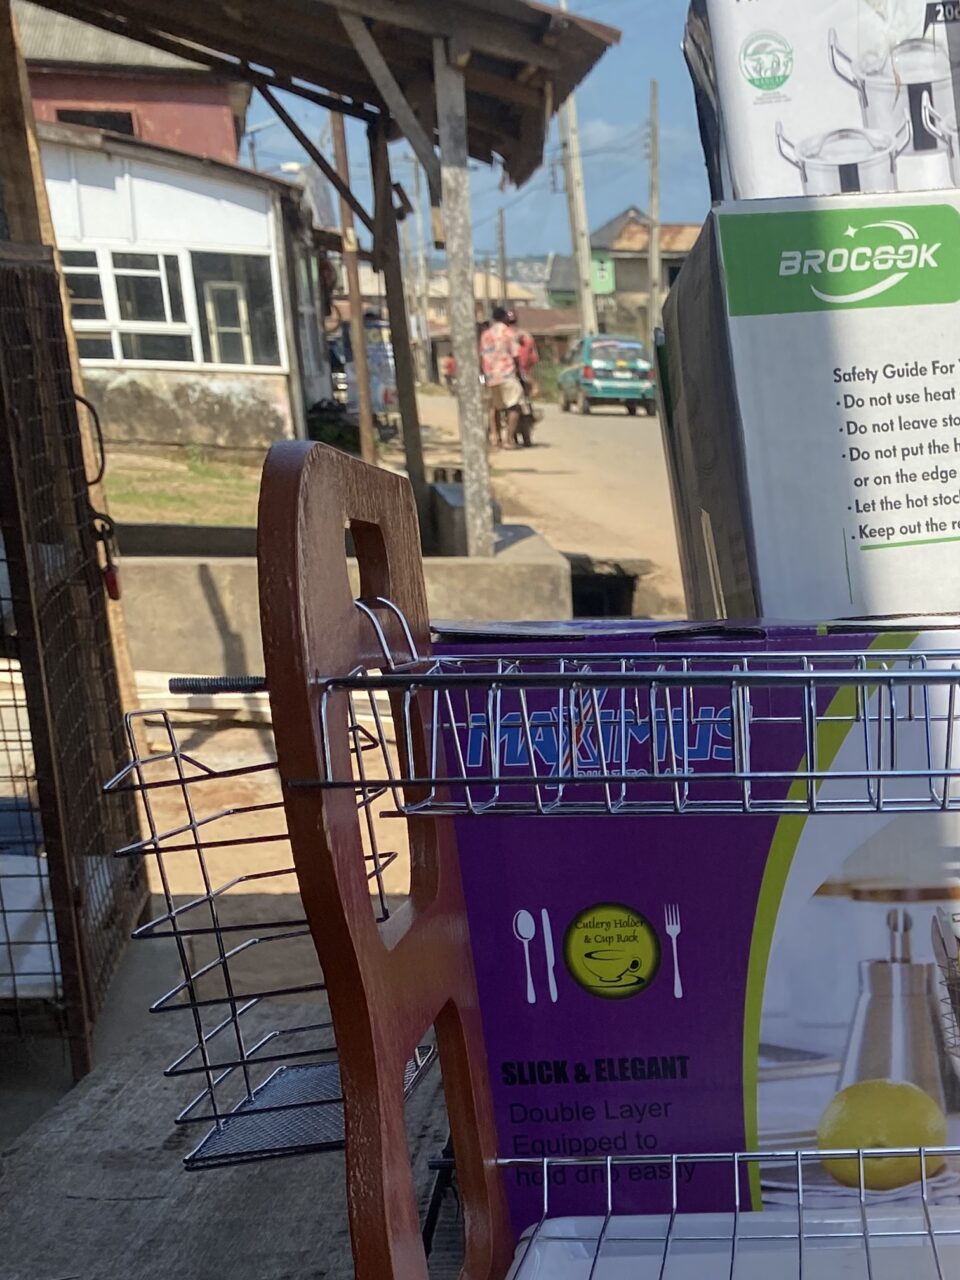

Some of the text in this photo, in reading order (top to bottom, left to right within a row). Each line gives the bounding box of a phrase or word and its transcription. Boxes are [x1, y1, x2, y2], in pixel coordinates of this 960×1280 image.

[779, 243, 941, 276] BROCOOK
[833, 366, 878, 384] Safety
[883, 361, 928, 379] Guide
[931, 360, 955, 376] For
[843, 394, 865, 409] Do
[869, 392, 892, 407] not
[896, 391, 920, 405] use
[924, 386, 956, 402] heat
[845, 421, 868, 436] Do
[872, 419, 895, 433] not
[898, 415, 938, 431] leave
[849, 446, 870, 462] Do
[874, 445, 897, 460] not
[901, 443, 924, 461] put
[928, 439, 950, 455] the
[854, 476, 870, 488] or
[873, 474, 891, 486] on
[895, 468, 917, 484] the
[921, 465, 957, 483] edge
[855, 499, 876, 514] Let
[880, 496, 902, 511] the
[906, 493, 928, 509] hot
[858, 524, 895, 540] Keep
[899, 521, 922, 535] out
[925, 517, 947, 533] the
[575, 915, 644, 931] Cutlery Holder
[584, 930, 639, 946] & Cup Rack
[501, 1055, 690, 1086] SLICK & ELEGANT
[509, 1099, 672, 1125] Double Layer
[513, 1130, 658, 1157] Equipped to
